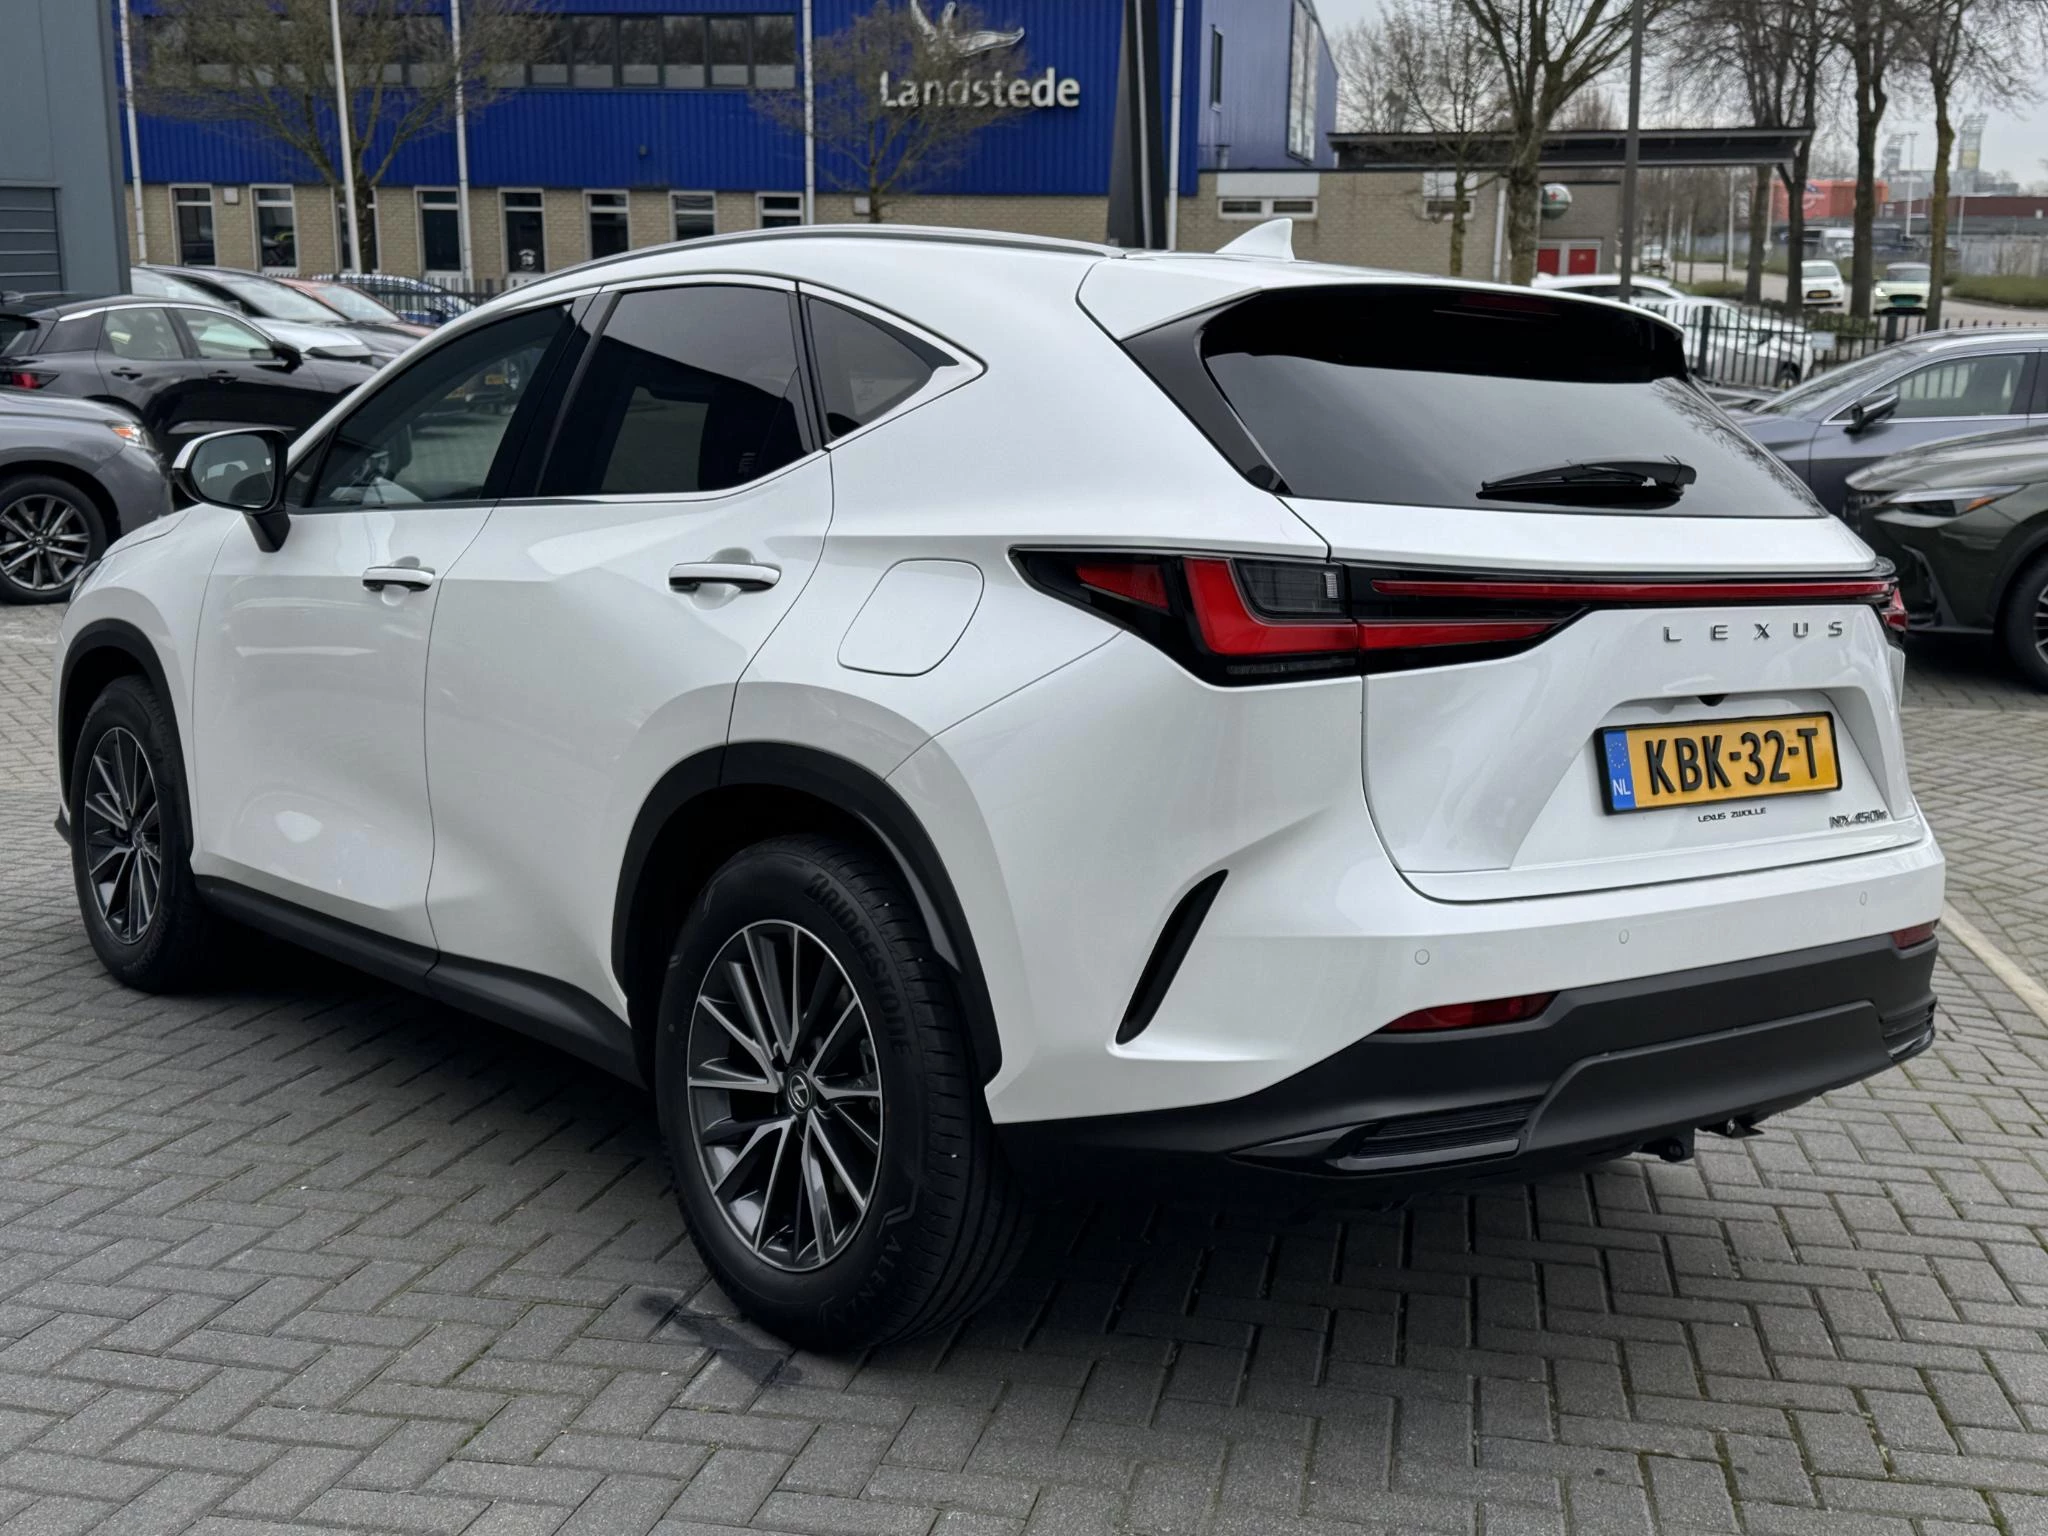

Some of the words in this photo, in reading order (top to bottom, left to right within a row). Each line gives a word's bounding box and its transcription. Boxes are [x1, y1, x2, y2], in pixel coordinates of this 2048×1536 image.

[879, 67, 1081, 107] Landstede
[1663, 621, 1843, 642] LEXUS
[1645, 728, 1819, 795] KBK-32-T
[1612, 778, 1632, 796] NL
[1697, 812, 1727, 823] LEXUS
[1730, 807, 1767, 818] ZWOLLE
[803, 872, 913, 1057] BRIDGESTONE
